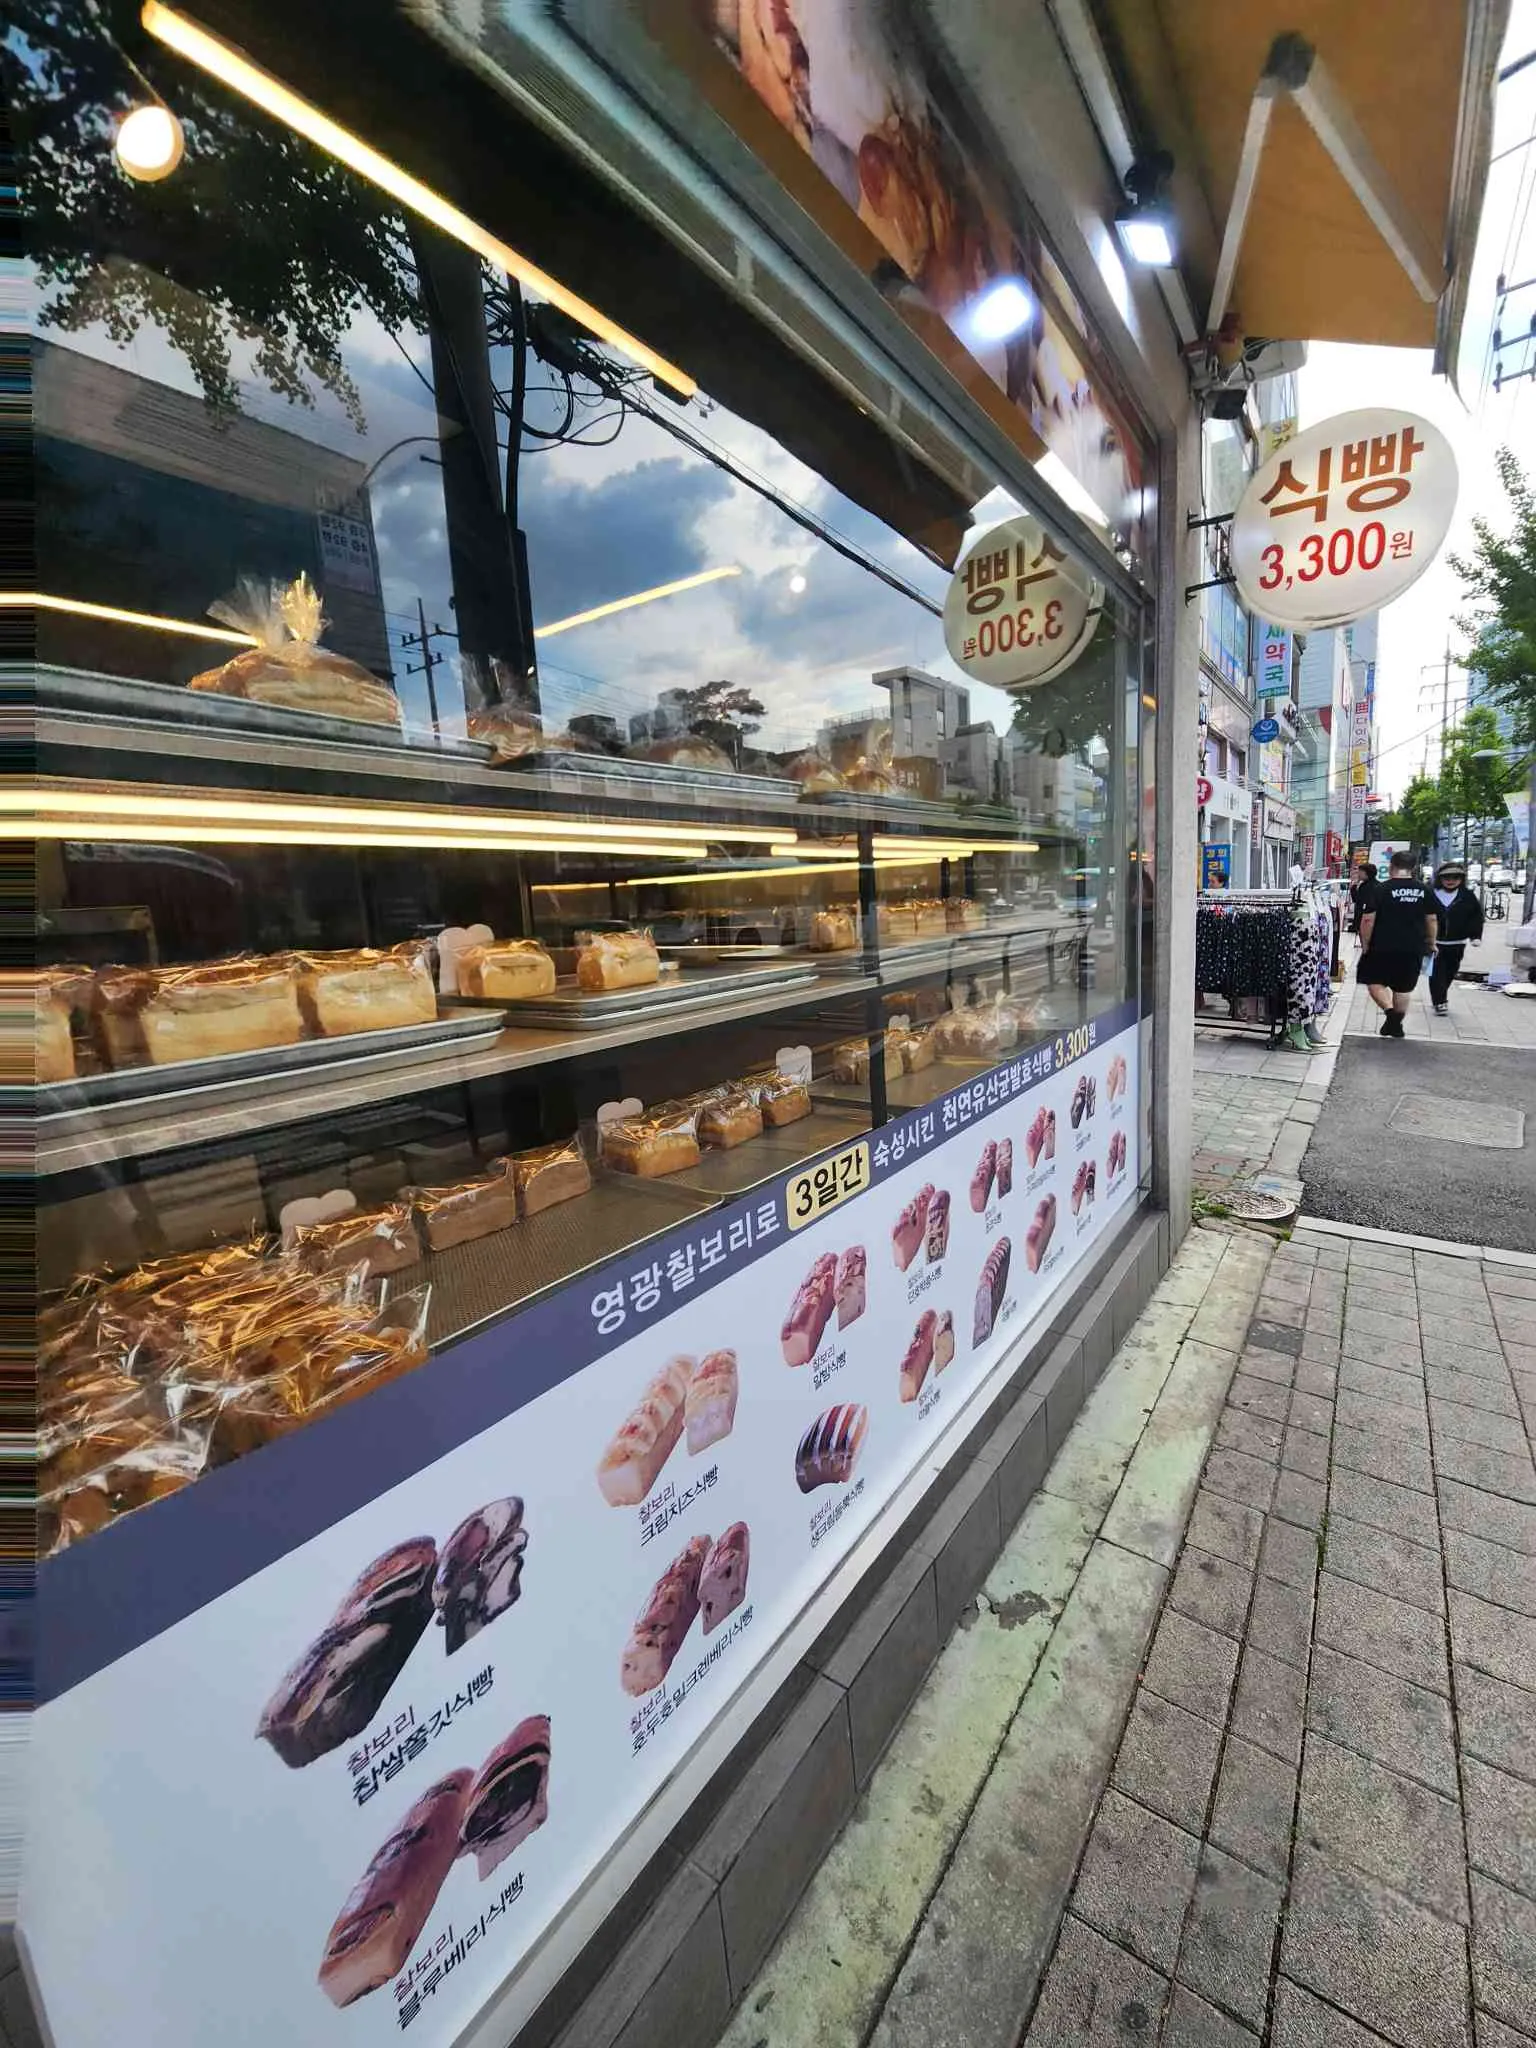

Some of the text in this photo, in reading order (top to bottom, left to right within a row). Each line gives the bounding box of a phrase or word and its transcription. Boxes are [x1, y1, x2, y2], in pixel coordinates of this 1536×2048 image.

[1259, 426, 1424, 522] 식빵
[1259, 522, 1414, 591] 3,300원
[1392, 888, 1425, 898] KOREA
[590, 1022, 1096, 1334] 영광찰보리로 3일간 숙성시킨 천연유산균발효식빵 3,300원
[638, 1482, 675, 1525] 찰보리
[640, 1463, 719, 1547] 크림치즈식빵
[630, 1683, 666, 1735] 찰보리
[631, 1605, 755, 1759] 호두호밀크렌베리식빵
[347, 1703, 416, 1777] 찰보리
[352, 1664, 495, 1807] 찹쌀쫄깃식빵
[393, 1923, 454, 2003] 찰보리
[397, 1871, 525, 2031] 블루베리식빵
